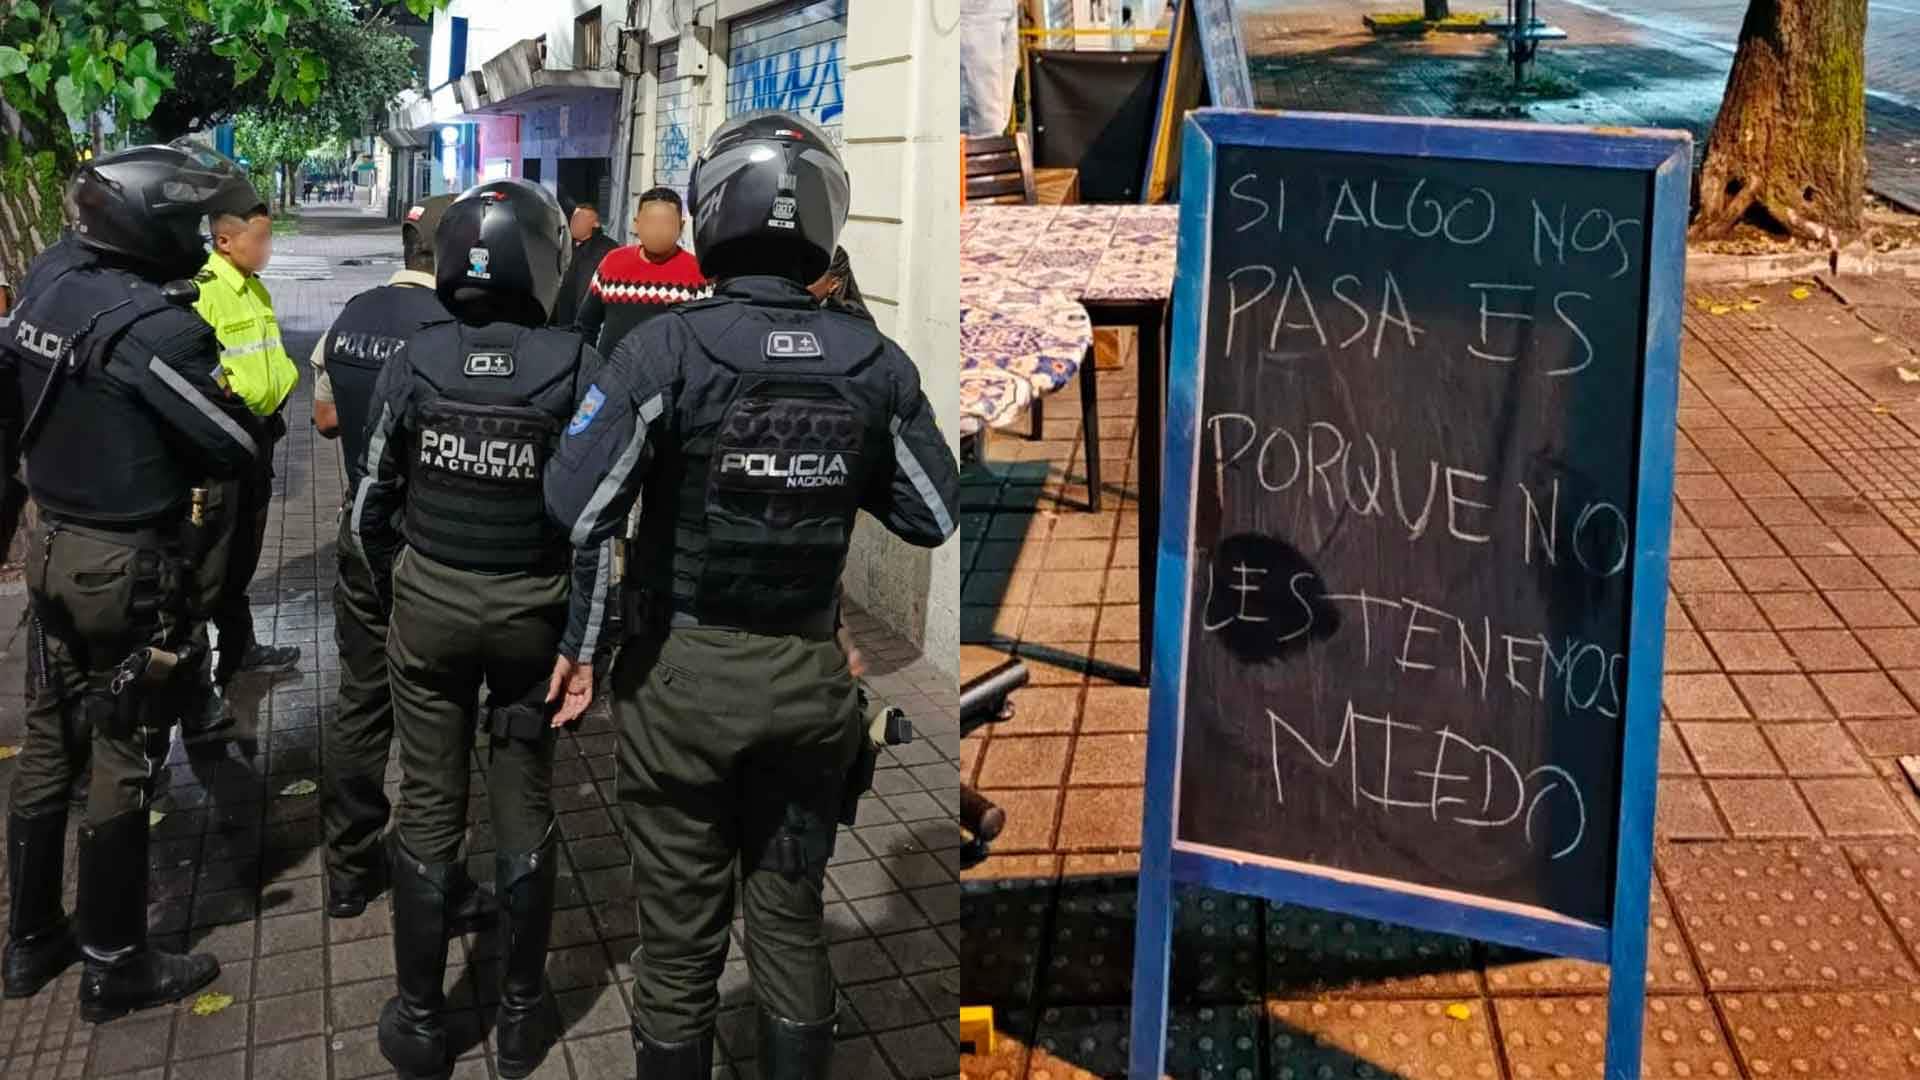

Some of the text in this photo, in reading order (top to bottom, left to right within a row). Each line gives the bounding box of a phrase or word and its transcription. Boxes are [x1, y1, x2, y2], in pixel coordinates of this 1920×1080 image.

[1229, 173, 1641, 278] SI ALGO NOS
[1226, 264, 1593, 376] PASA ES
[420, 450, 535, 479] NACIONAL
[421, 429, 536, 467] POLICIA
[720, 453, 849, 477] POLICIA
[786, 476, 846, 488] NACIONAL
[1207, 413, 1629, 577] PORQUE NO
[1203, 561, 1625, 718] LES TENEMOS
[1266, 700, 1586, 859] MIEDO
